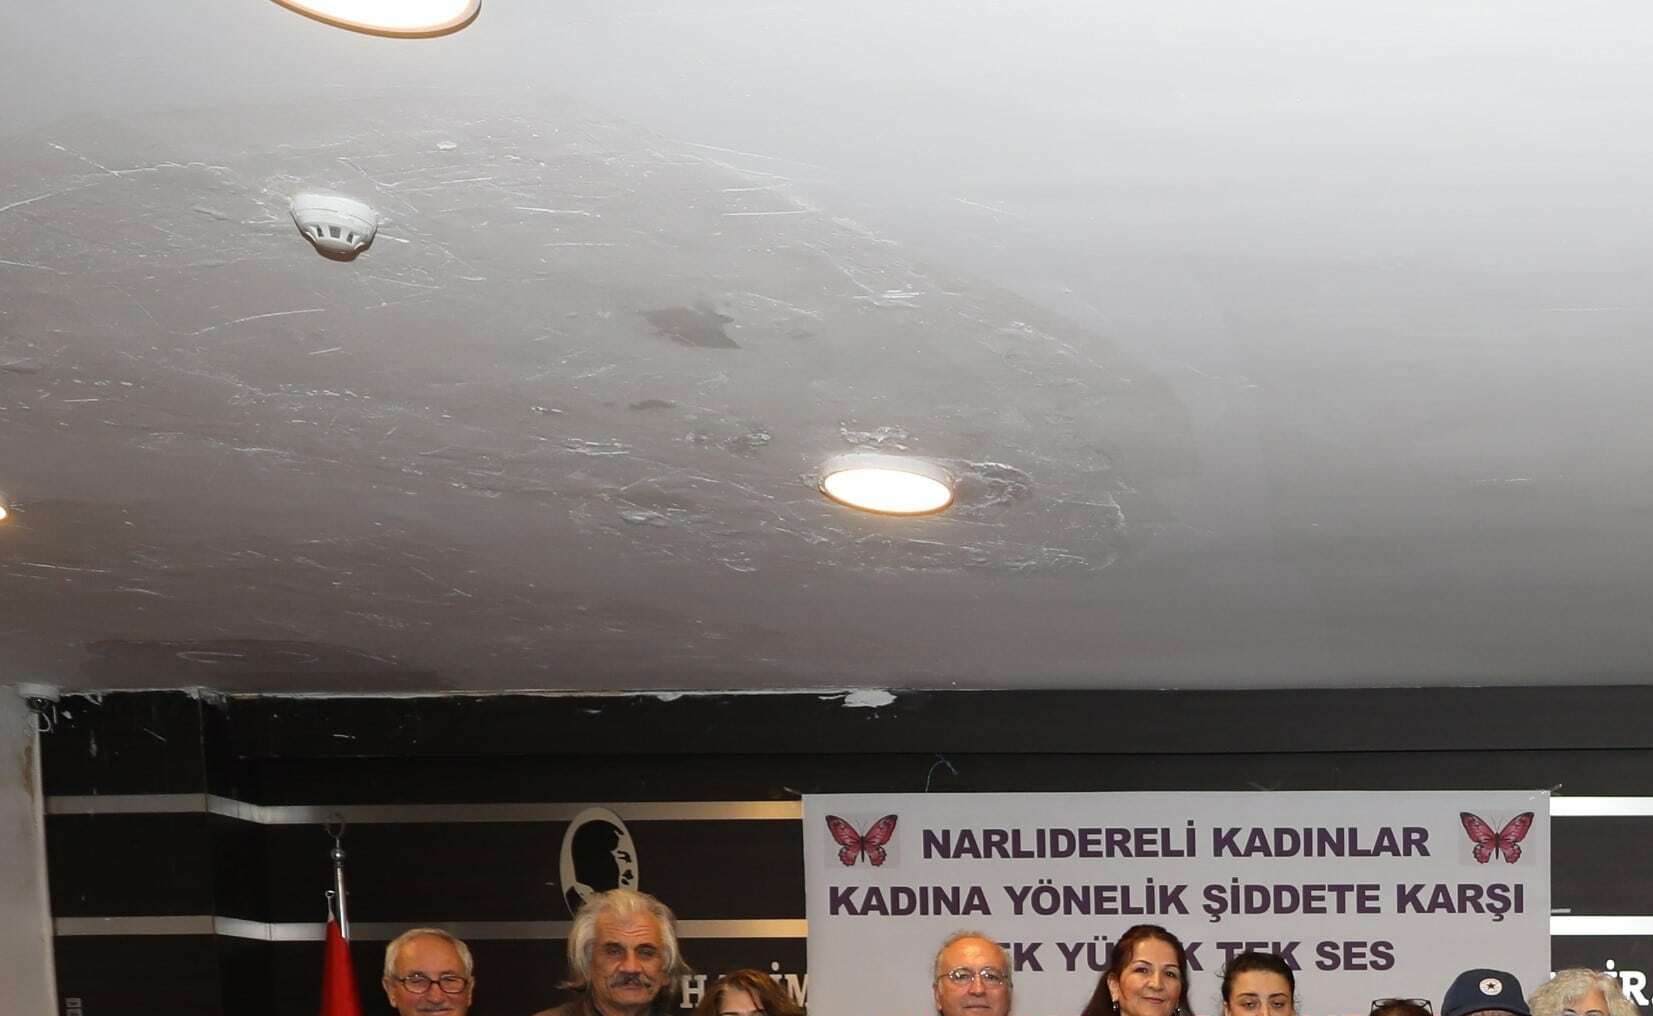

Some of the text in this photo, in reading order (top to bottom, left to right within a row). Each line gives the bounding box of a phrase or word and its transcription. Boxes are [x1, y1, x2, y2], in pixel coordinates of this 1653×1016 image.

[922, 820, 1431, 859] NARLIDERELİ KADINLAR
[828, 877, 1524, 923] KADINA YÖNELİK ŞİDDETE KARŞI
[1315, 940, 1396, 972] SES
